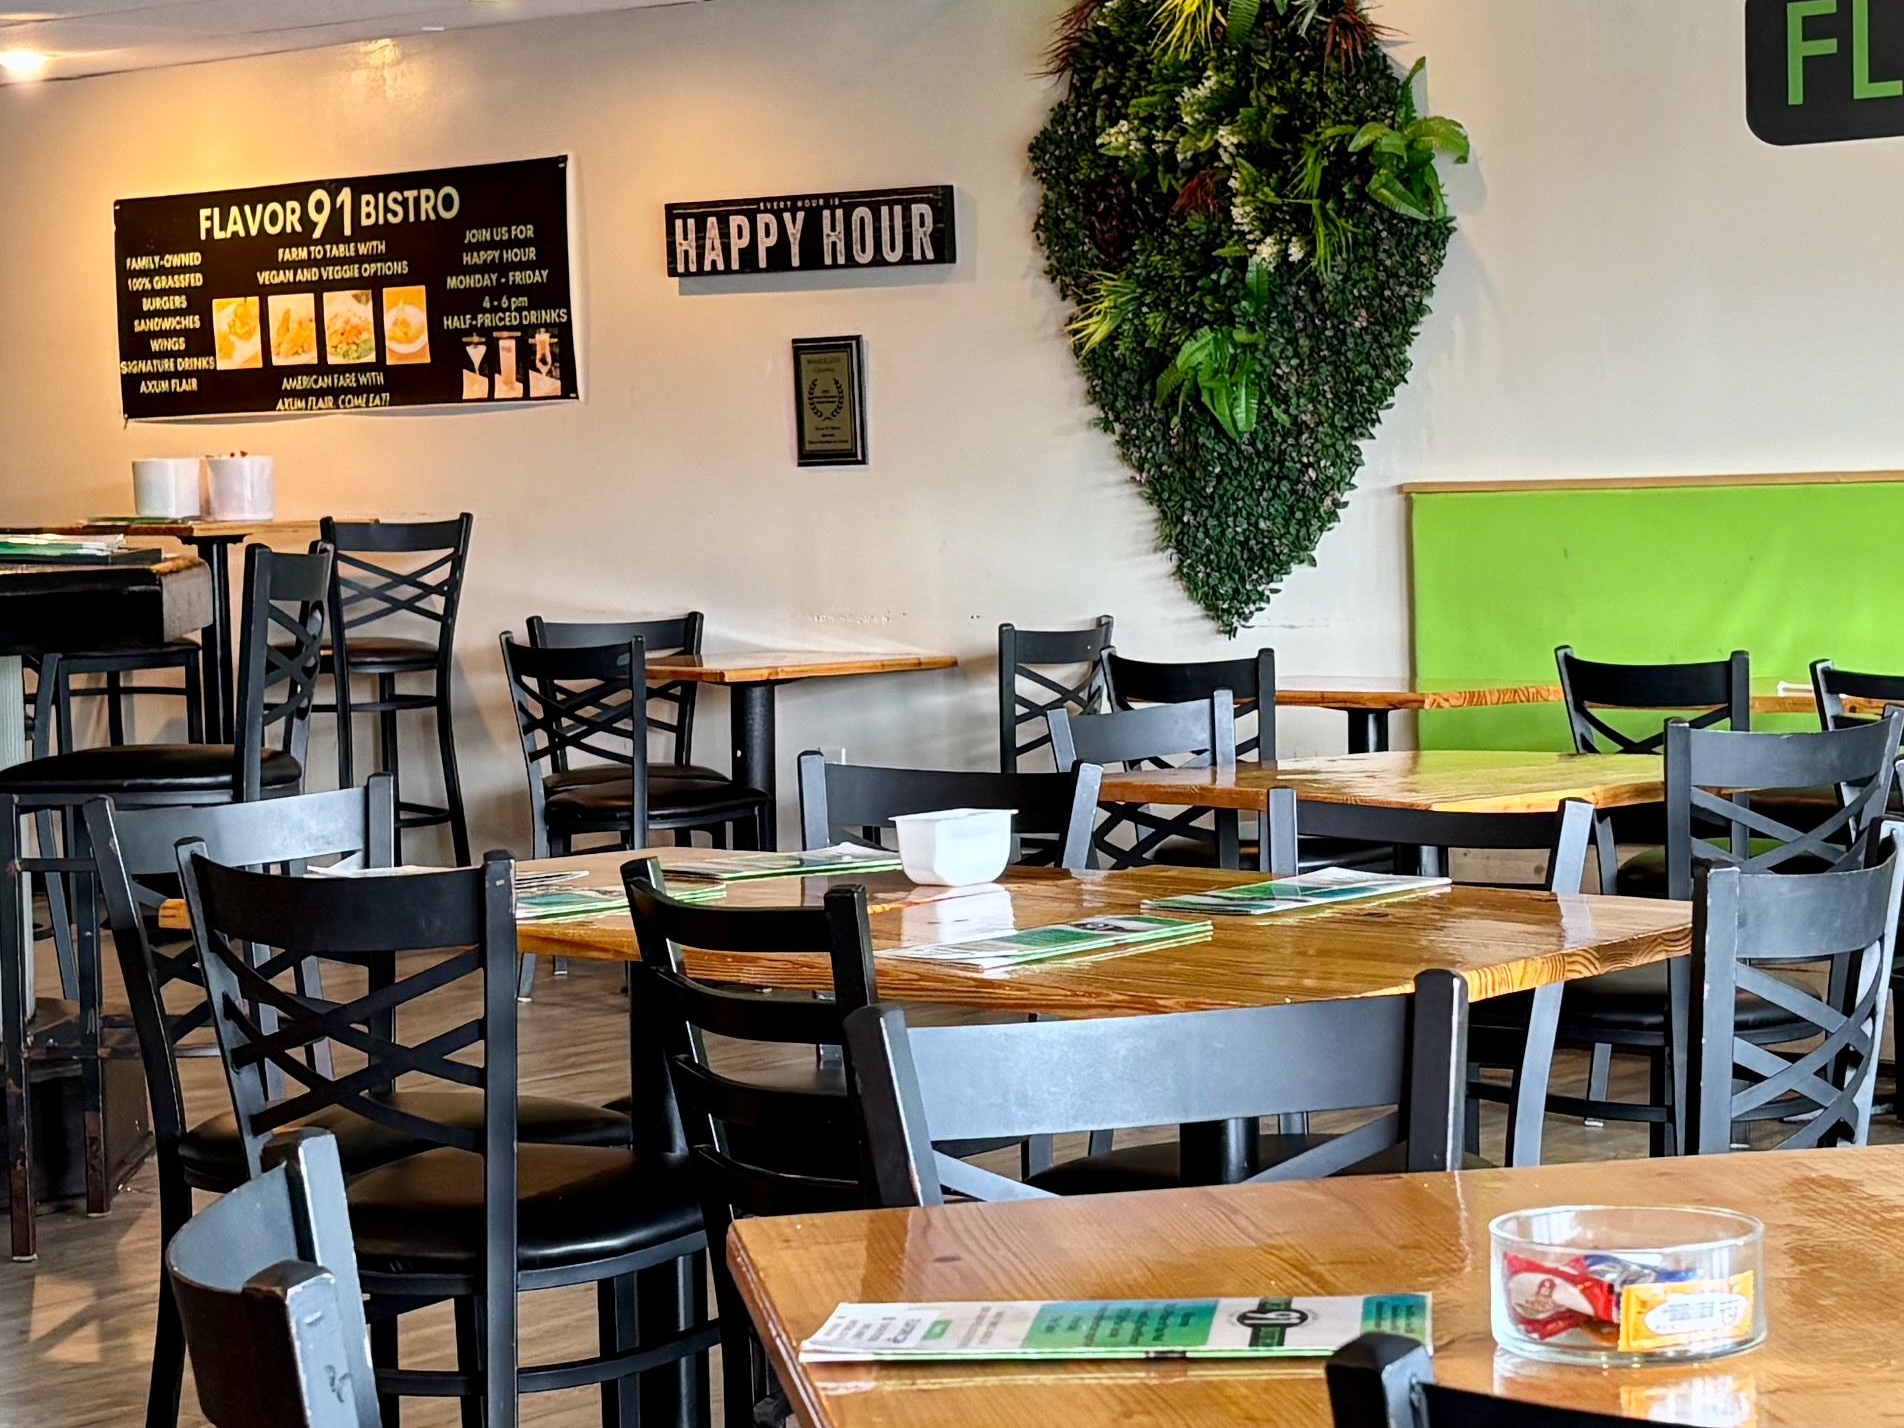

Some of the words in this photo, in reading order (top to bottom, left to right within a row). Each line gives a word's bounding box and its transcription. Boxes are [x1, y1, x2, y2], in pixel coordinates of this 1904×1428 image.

[199, 200, 303, 241] FLAVOR
[307, 186, 352, 240] 91
[360, 185, 460, 227] BISTRO
[464, 228, 491, 244] JOIN
[493, 226, 509, 241] US
[511, 224, 535, 240] FOR
[674, 210, 805, 273] HAPPY
[822, 203, 935, 266] HOUR
[278, 246, 308, 263] FARM
[309, 245, 324, 260] TO
[325, 243, 356, 259] TABLE
[357, 240, 386, 256] WITH
[462, 249, 500, 266] HAPPY
[502, 247, 537, 263] HOUR
[126, 252, 202, 270] FAMILY-OWNED
[257, 269, 294, 285] VEGAN
[296, 266, 319, 282] AND
[320, 264, 360, 281] VEGGIE
[361, 260, 409, 277] OPTIONS
[446, 272, 498, 290] MONDAY
[508, 269, 549, 285] FRIDAY
[128, 278, 151, 291] 100%
[153, 273, 203, 289] GRASSFED
[143, 295, 187, 311] BURGERS
[482, 295, 491, 309] 4
[501, 294, 509, 308] 6
[511, 296, 528, 311] pm
[134, 315, 200, 332] SANDWICHES
[443, 312, 520, 330] HALF-PRICED
[522, 308, 568, 325] DRINKS
[150, 337, 186, 352] WINGS
[120, 359, 175, 374] SIGNATURE
[177, 356, 215, 371] DRINKS
[140, 379, 169, 393] AXUM
[171, 378, 198, 392] FLAIR
[281, 374, 332, 391] AMERICAN
[334, 372, 357, 387] FARE
[357, 371, 385, 386] WITH
[276, 398, 306, 411] AXUM
[338, 394, 367, 409] COME
